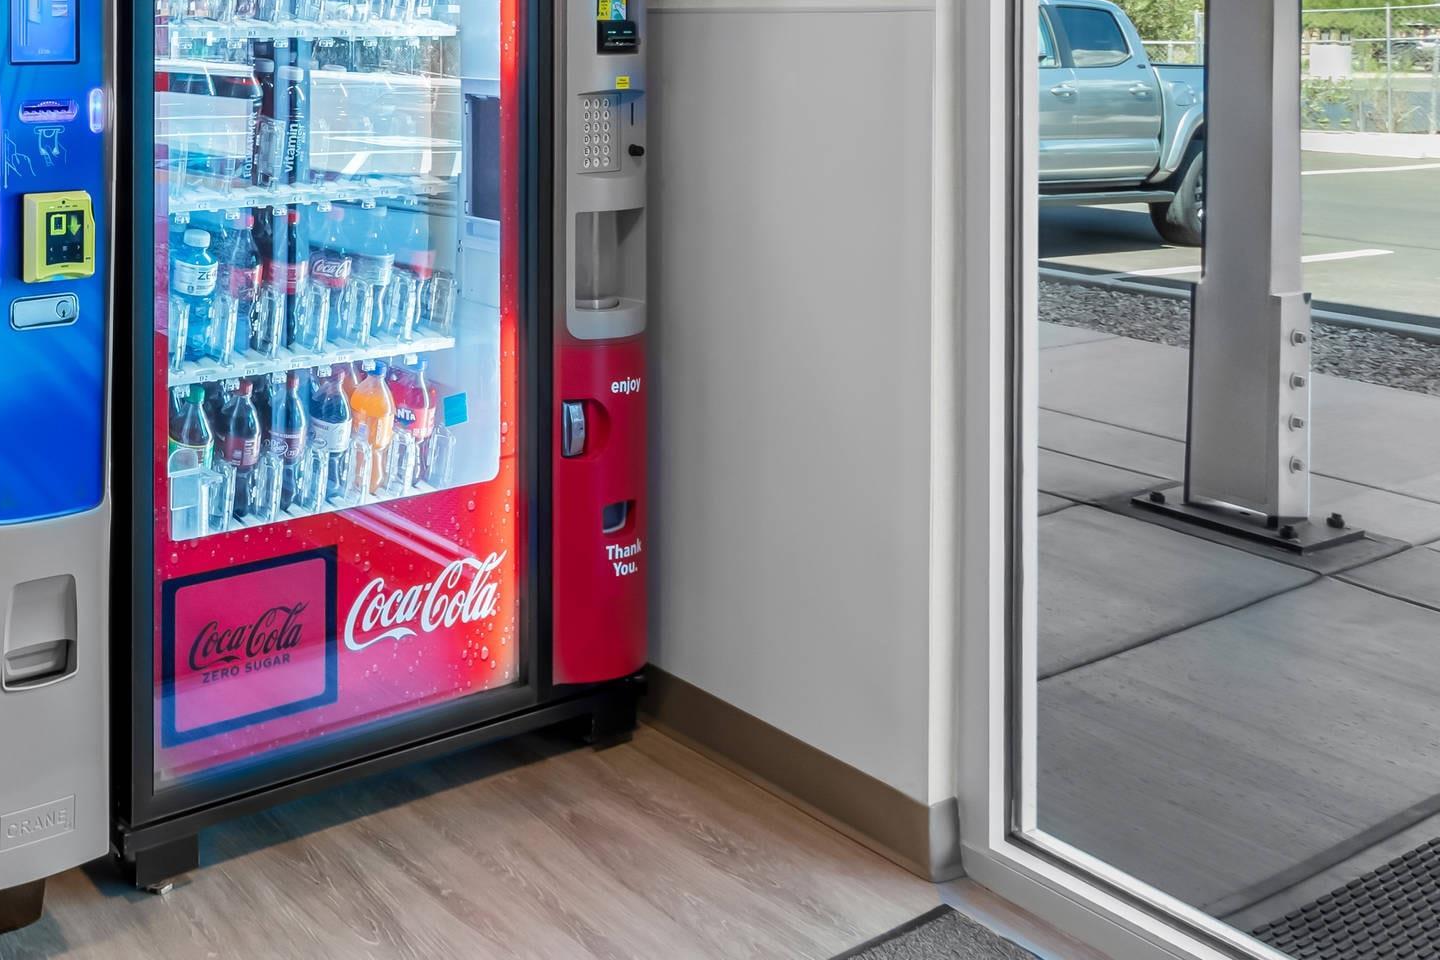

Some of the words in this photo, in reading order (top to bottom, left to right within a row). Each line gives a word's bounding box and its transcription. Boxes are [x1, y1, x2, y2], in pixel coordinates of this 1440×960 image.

[611, 376, 641, 394] enjoy
[606, 537, 642, 560] Thank
[613, 560, 638, 577] You.
[344, 549, 508, 651] Coca-Cola
[188, 600, 311, 671] Coca-Cola
[201, 664, 241, 685] ZERO
[244, 651, 291, 675] SUGAR
[6, 808, 66, 839] CRANE
